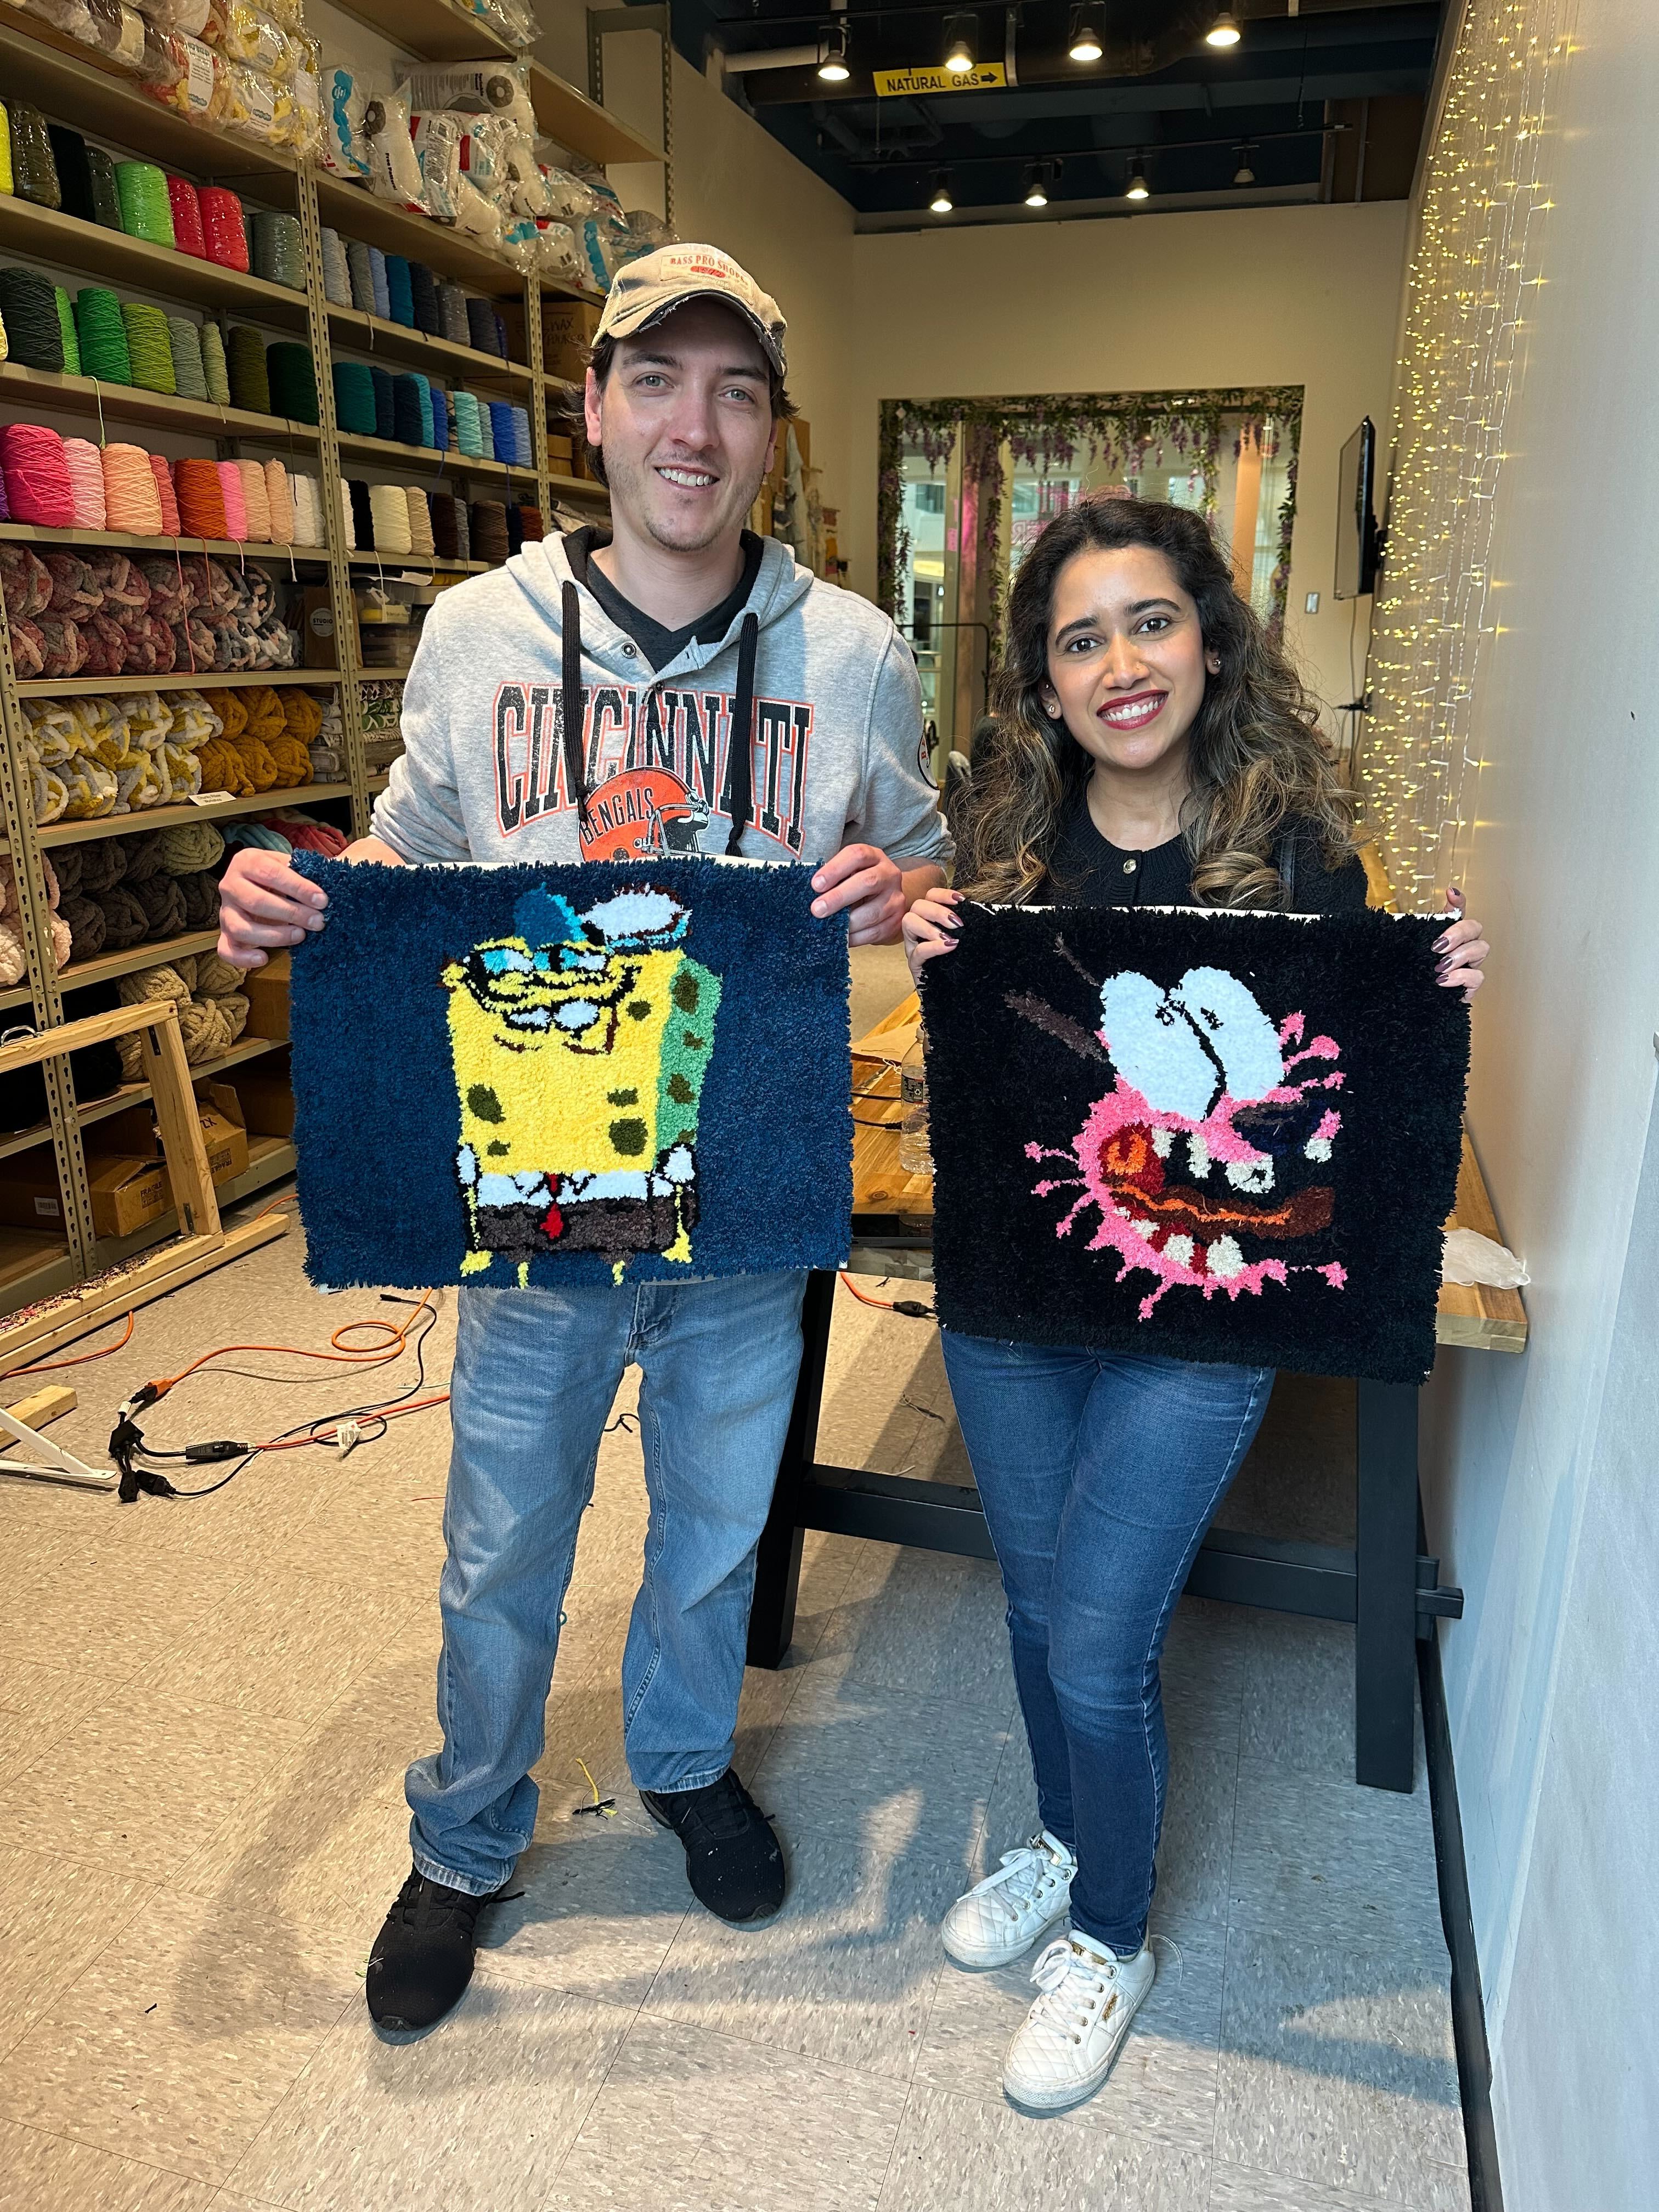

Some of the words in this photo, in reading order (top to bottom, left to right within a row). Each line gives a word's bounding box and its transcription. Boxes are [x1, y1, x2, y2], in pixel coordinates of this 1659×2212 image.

[887, 76, 946, 92] NATURAL
[952, 73, 979, 87] GAS
[670, 256, 693, 265] BASS
[696, 255, 715, 267] PRO
[718, 261, 745, 283] SHOPS
[580, 788, 654, 845] BENGALS
[210, 1158, 233, 1173] FRAGILE
[140, 1181, 163, 1197] FRAGILE
